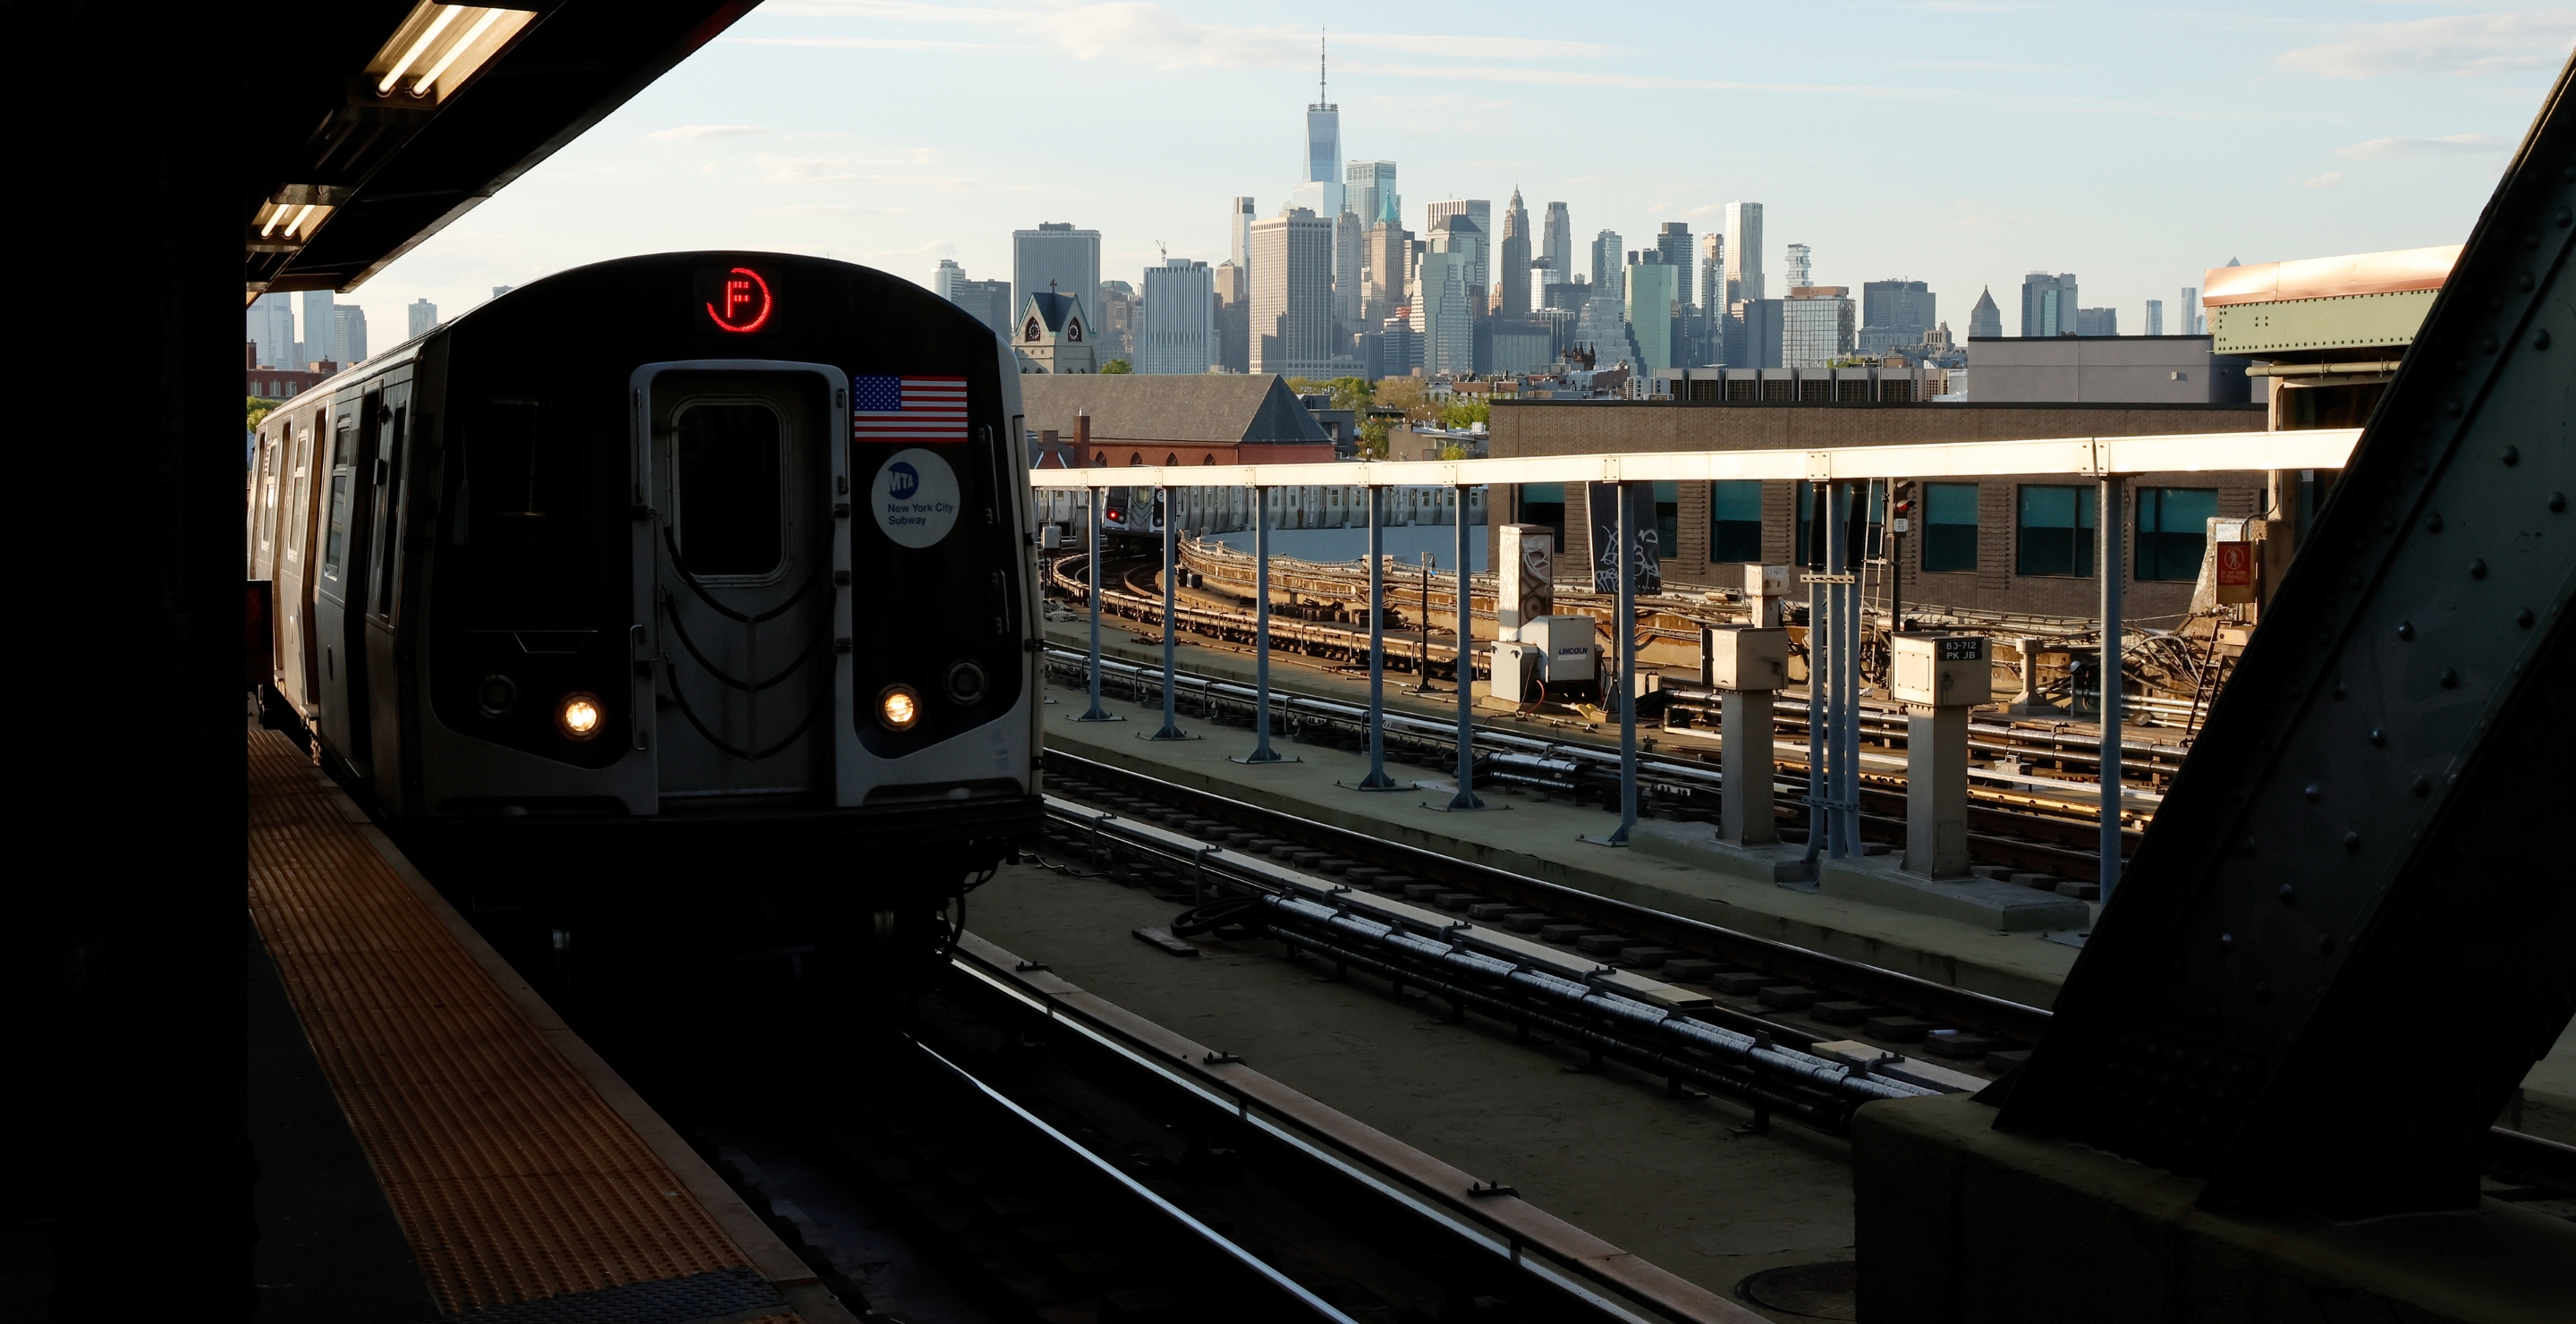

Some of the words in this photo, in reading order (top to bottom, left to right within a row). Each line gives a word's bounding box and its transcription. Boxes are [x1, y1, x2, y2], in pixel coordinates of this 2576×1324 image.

[727, 281, 750, 318] F
[887, 470, 915, 493] MTA
[887, 504, 910, 513] New
[912, 504, 933, 513] York
[936, 503, 953, 513] City
[888, 515, 927, 526] Subway
[1945, 641, 1977, 650] B3-712
[1558, 647, 1588, 655] LINCOLN
[1946, 651, 1960, 660] PK
[1962, 650, 1976, 659] JB
